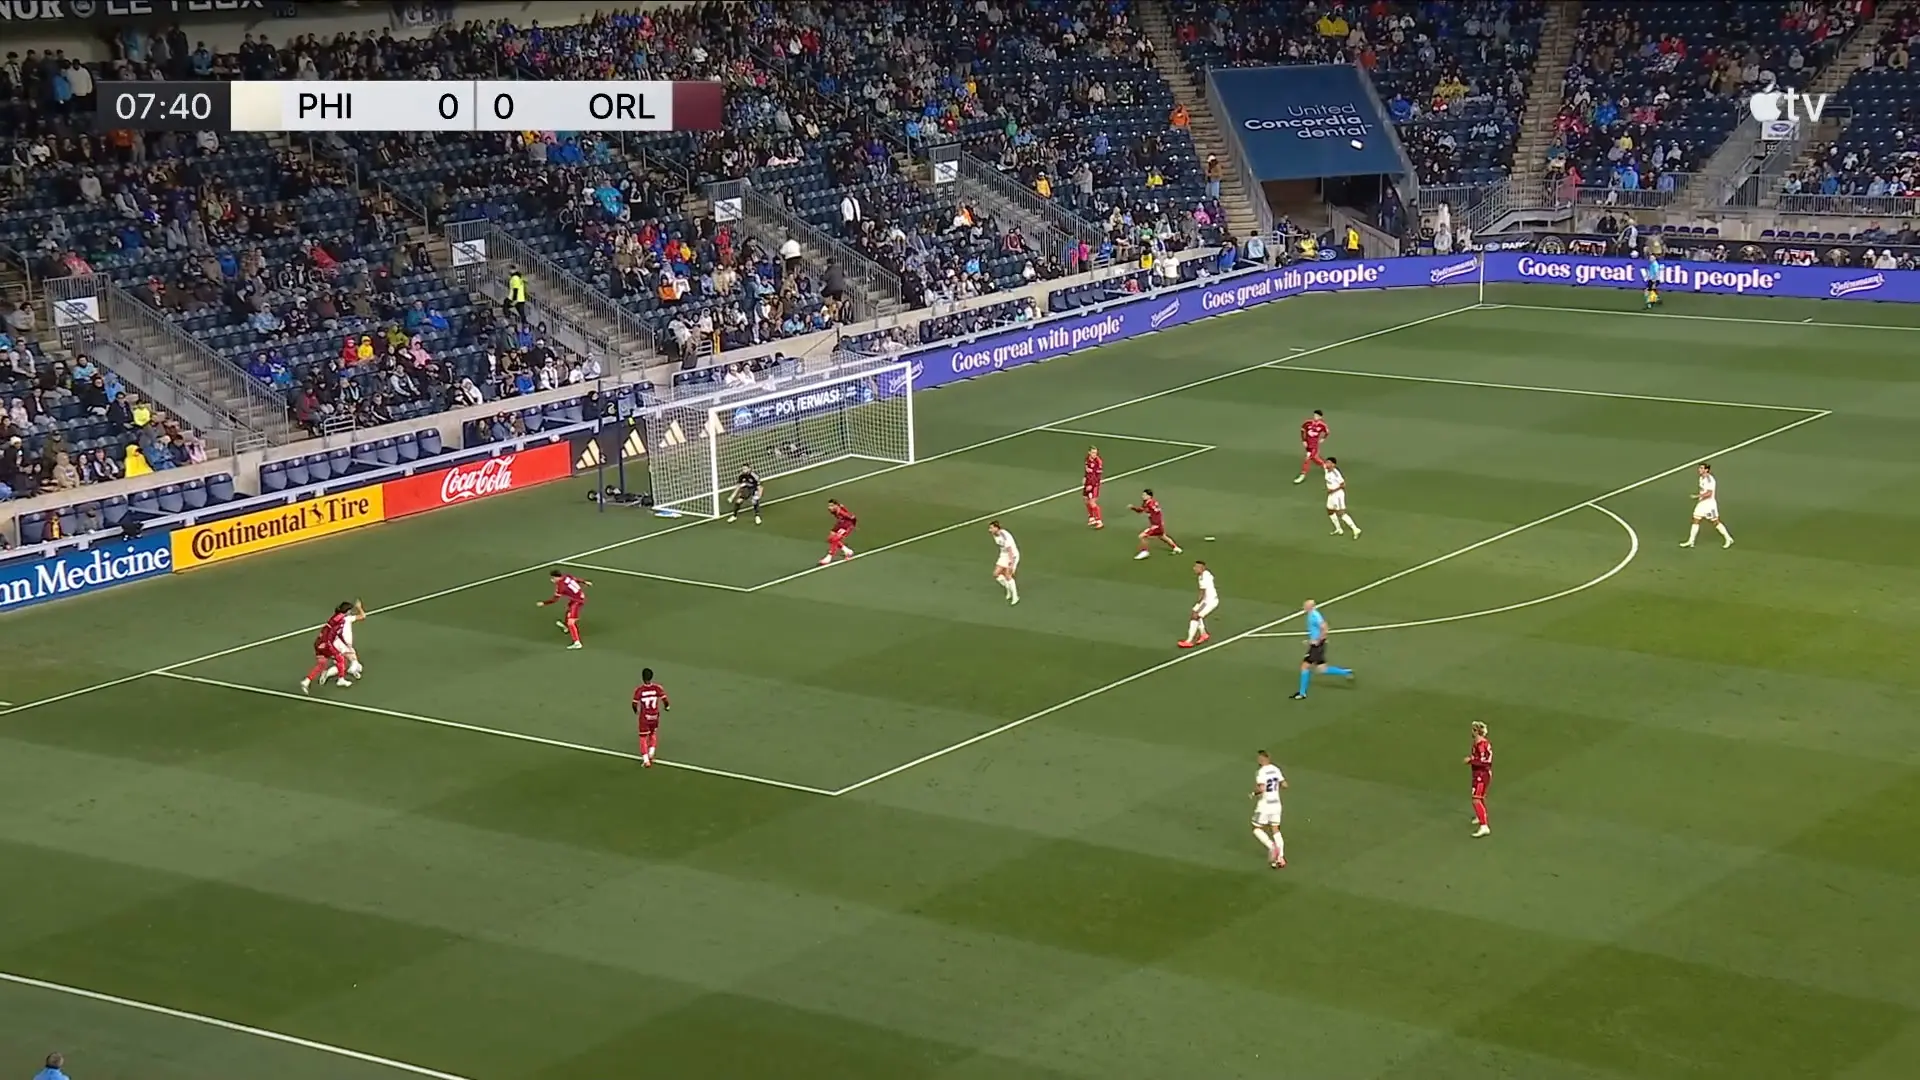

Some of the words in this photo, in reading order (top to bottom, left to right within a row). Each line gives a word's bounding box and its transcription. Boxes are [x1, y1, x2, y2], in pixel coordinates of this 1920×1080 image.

[1244, 115, 1363, 130] Concordia
[1287, 103, 1356, 117] United
[1518, 257, 1571, 279] Goes
[1576, 259, 1635, 285] great
[1202, 289, 1235, 310] Goes
[1237, 279, 1271, 307] great
[1274, 270, 1301, 297] with
[952, 348, 991, 373] Goes
[993, 337, 1034, 369] great
[1037, 326, 1069, 352] with
[191, 507, 306, 560] Continental
[324, 494, 369, 523] Tire
[35, 546, 170, 597] Medicine
[1266, 777, 1279, 793] 27
